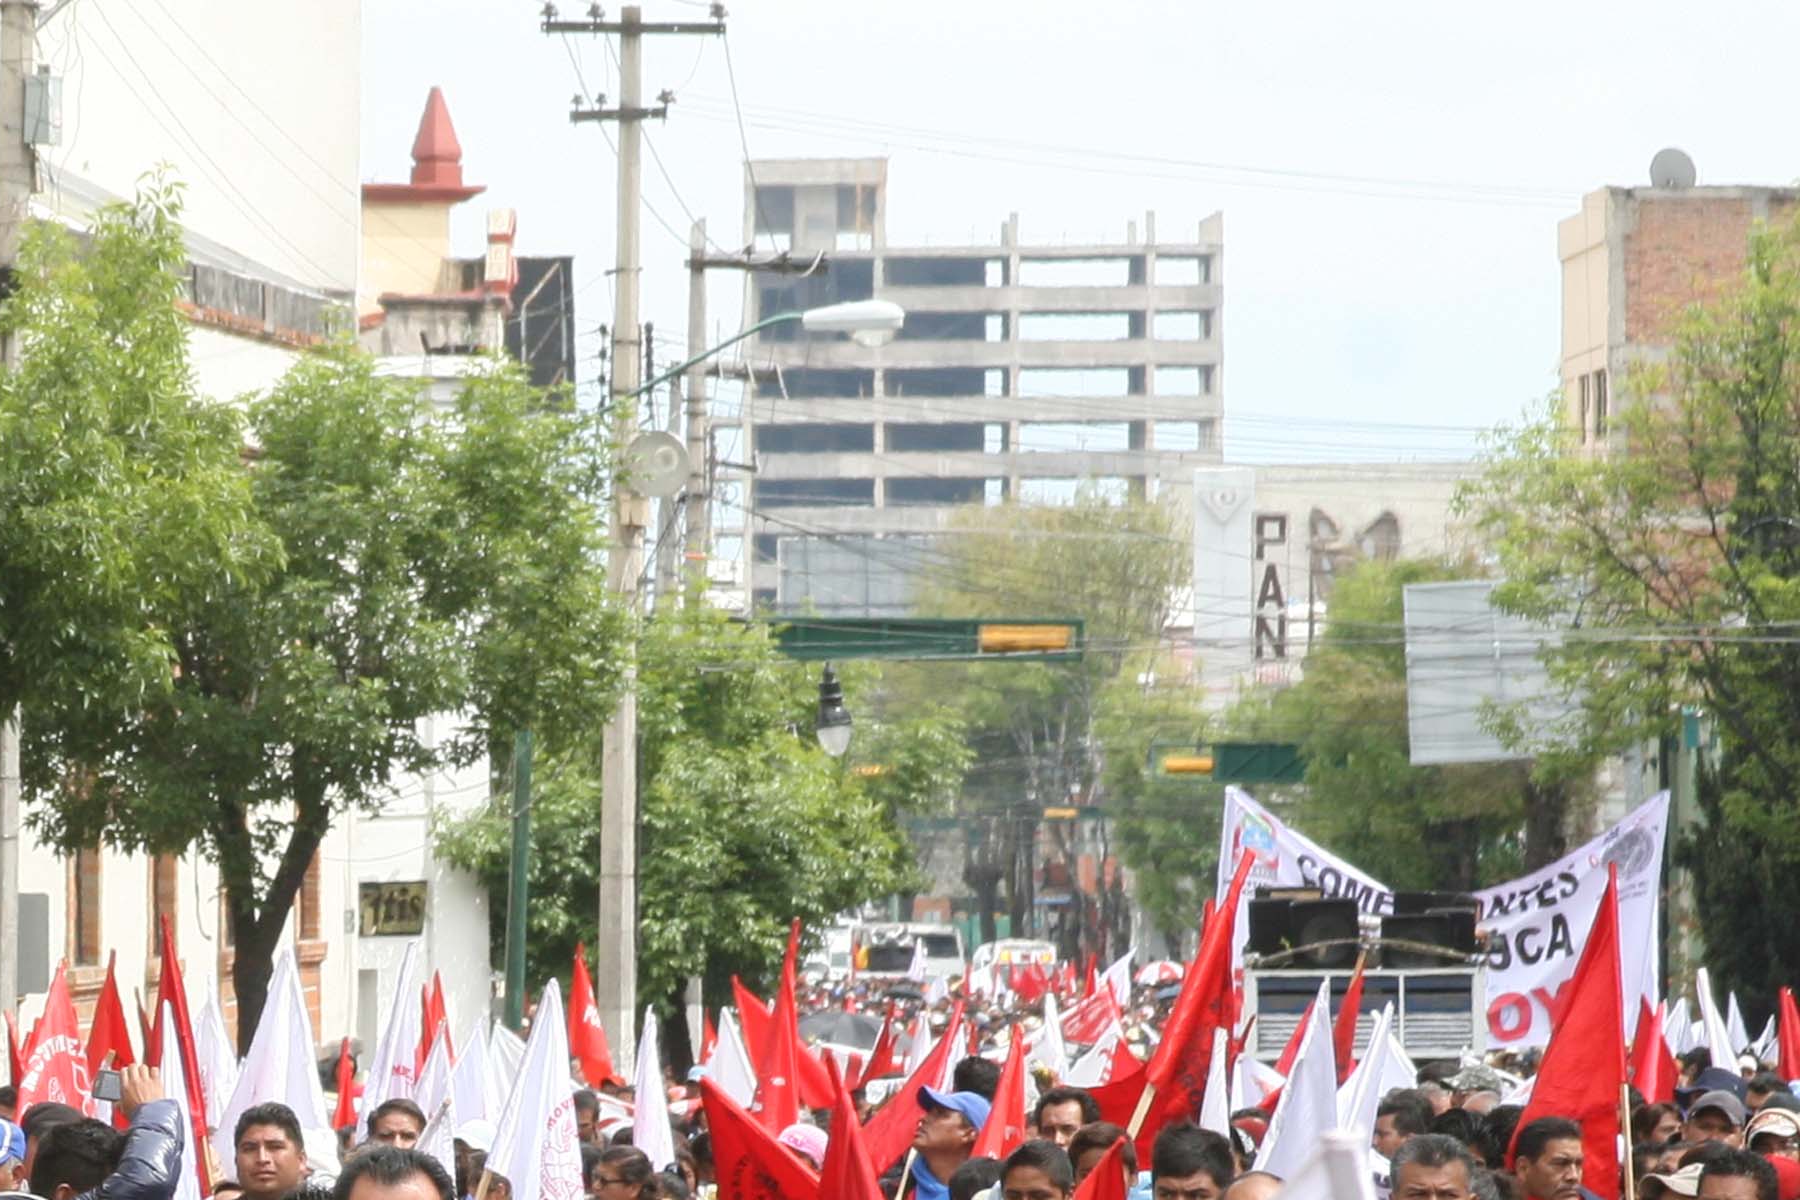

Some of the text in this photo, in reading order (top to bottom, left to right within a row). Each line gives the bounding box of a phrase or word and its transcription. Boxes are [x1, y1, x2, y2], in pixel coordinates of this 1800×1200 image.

[1255, 515, 1286, 660] PAN
[1487, 912, 1575, 971] UCA
[1486, 977, 1576, 1043] OY
